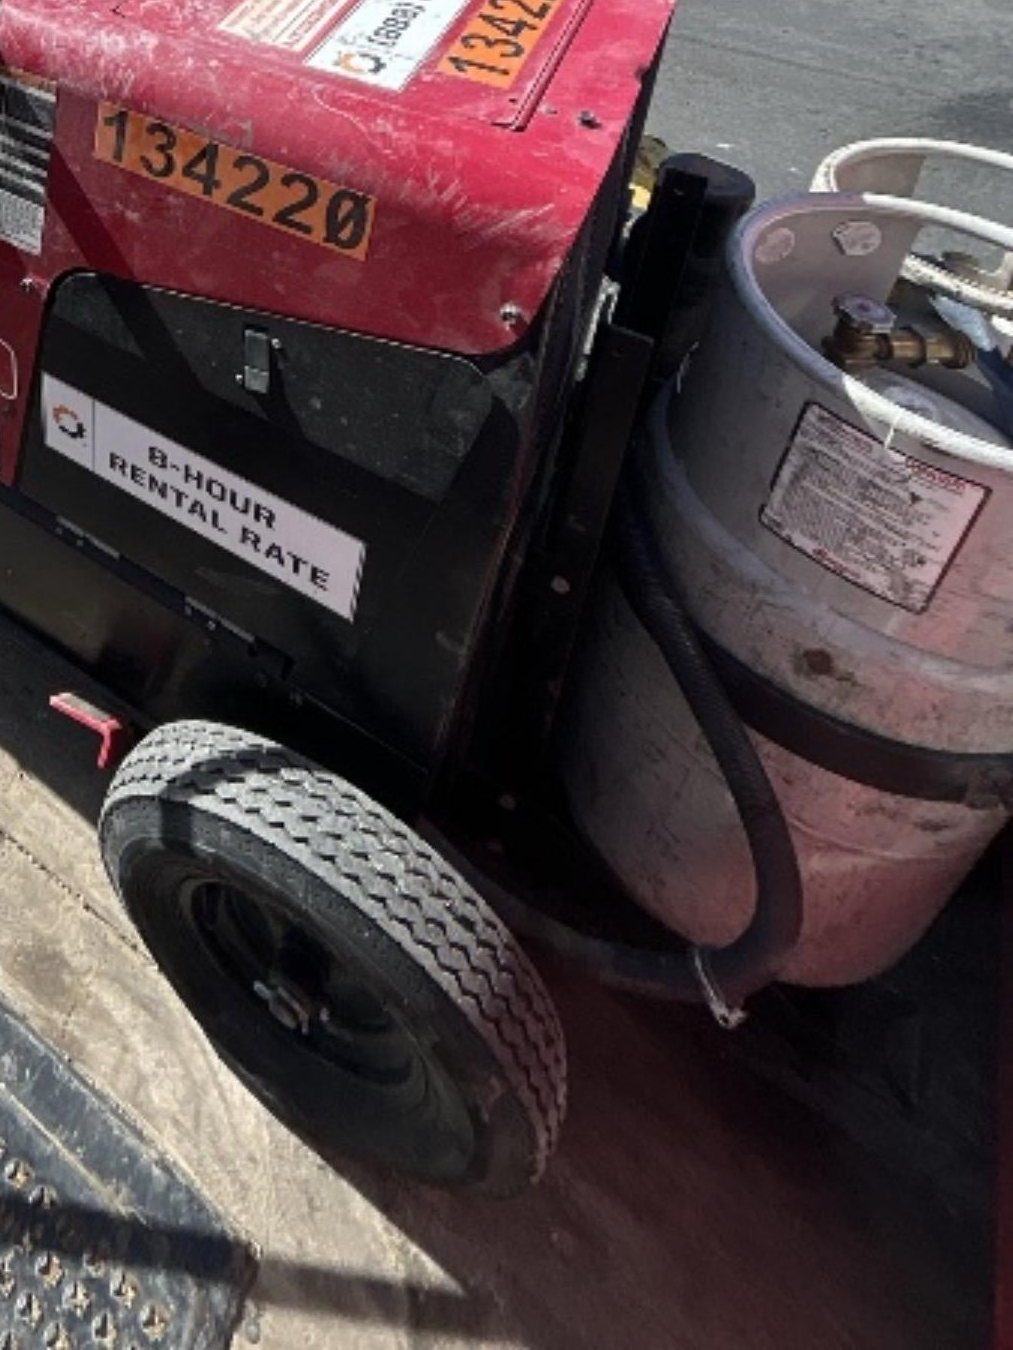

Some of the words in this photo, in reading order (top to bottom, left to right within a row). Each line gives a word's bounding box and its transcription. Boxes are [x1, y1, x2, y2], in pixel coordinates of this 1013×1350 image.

[103, 111, 369, 250] 134220
[109, 451, 228, 534] RENTAL
[240, 525, 330, 593] RATE
[147, 446, 276, 531] 8-HOUR
